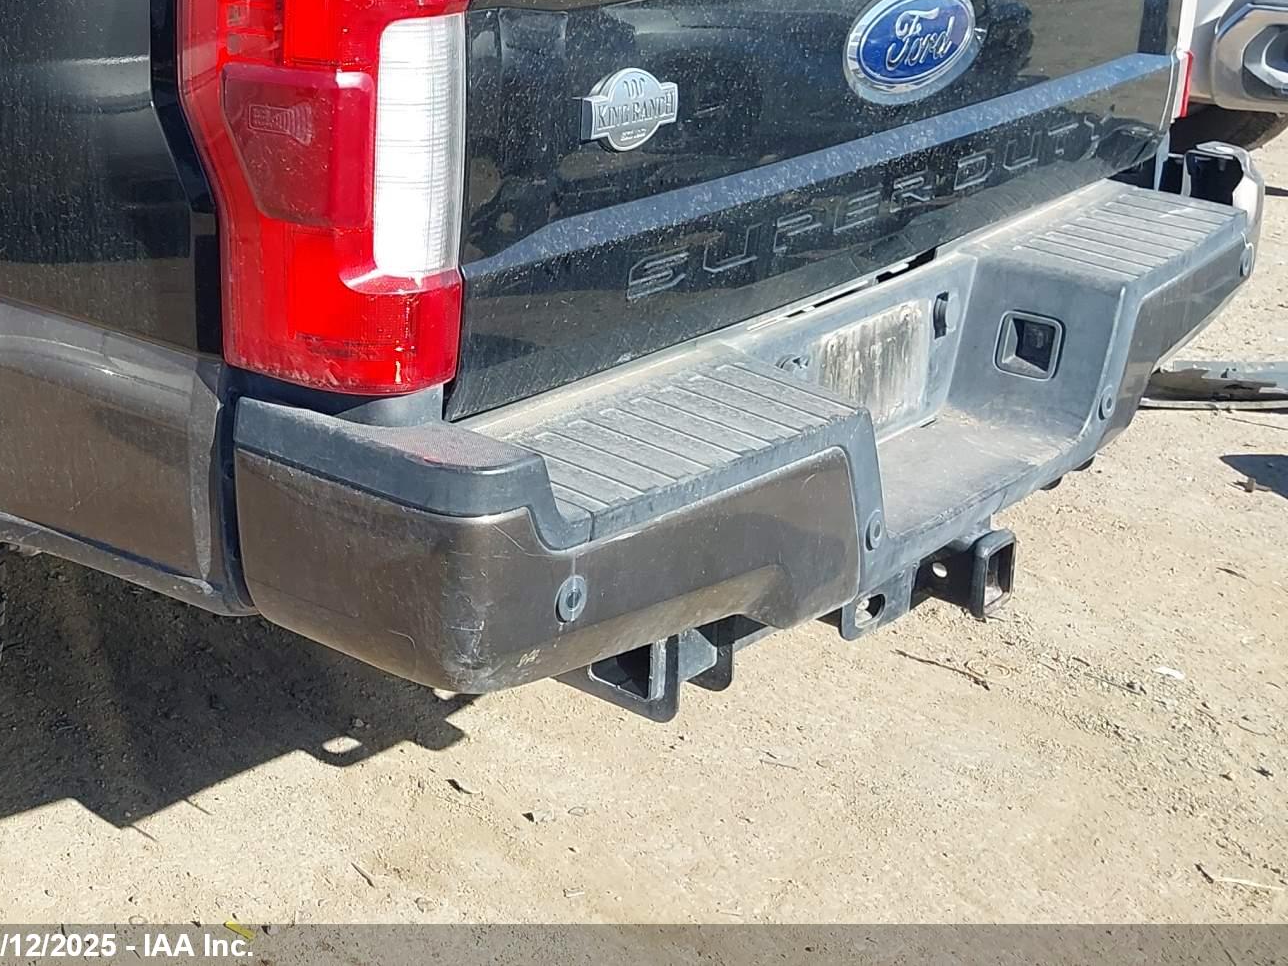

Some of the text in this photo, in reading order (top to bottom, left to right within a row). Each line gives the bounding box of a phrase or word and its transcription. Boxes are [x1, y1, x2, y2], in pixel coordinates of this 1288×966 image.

[885, 7, 956, 72] Ford
[596, 88, 675, 129] KING RANCH
[626, 113, 1113, 300] SUPER DUTY
